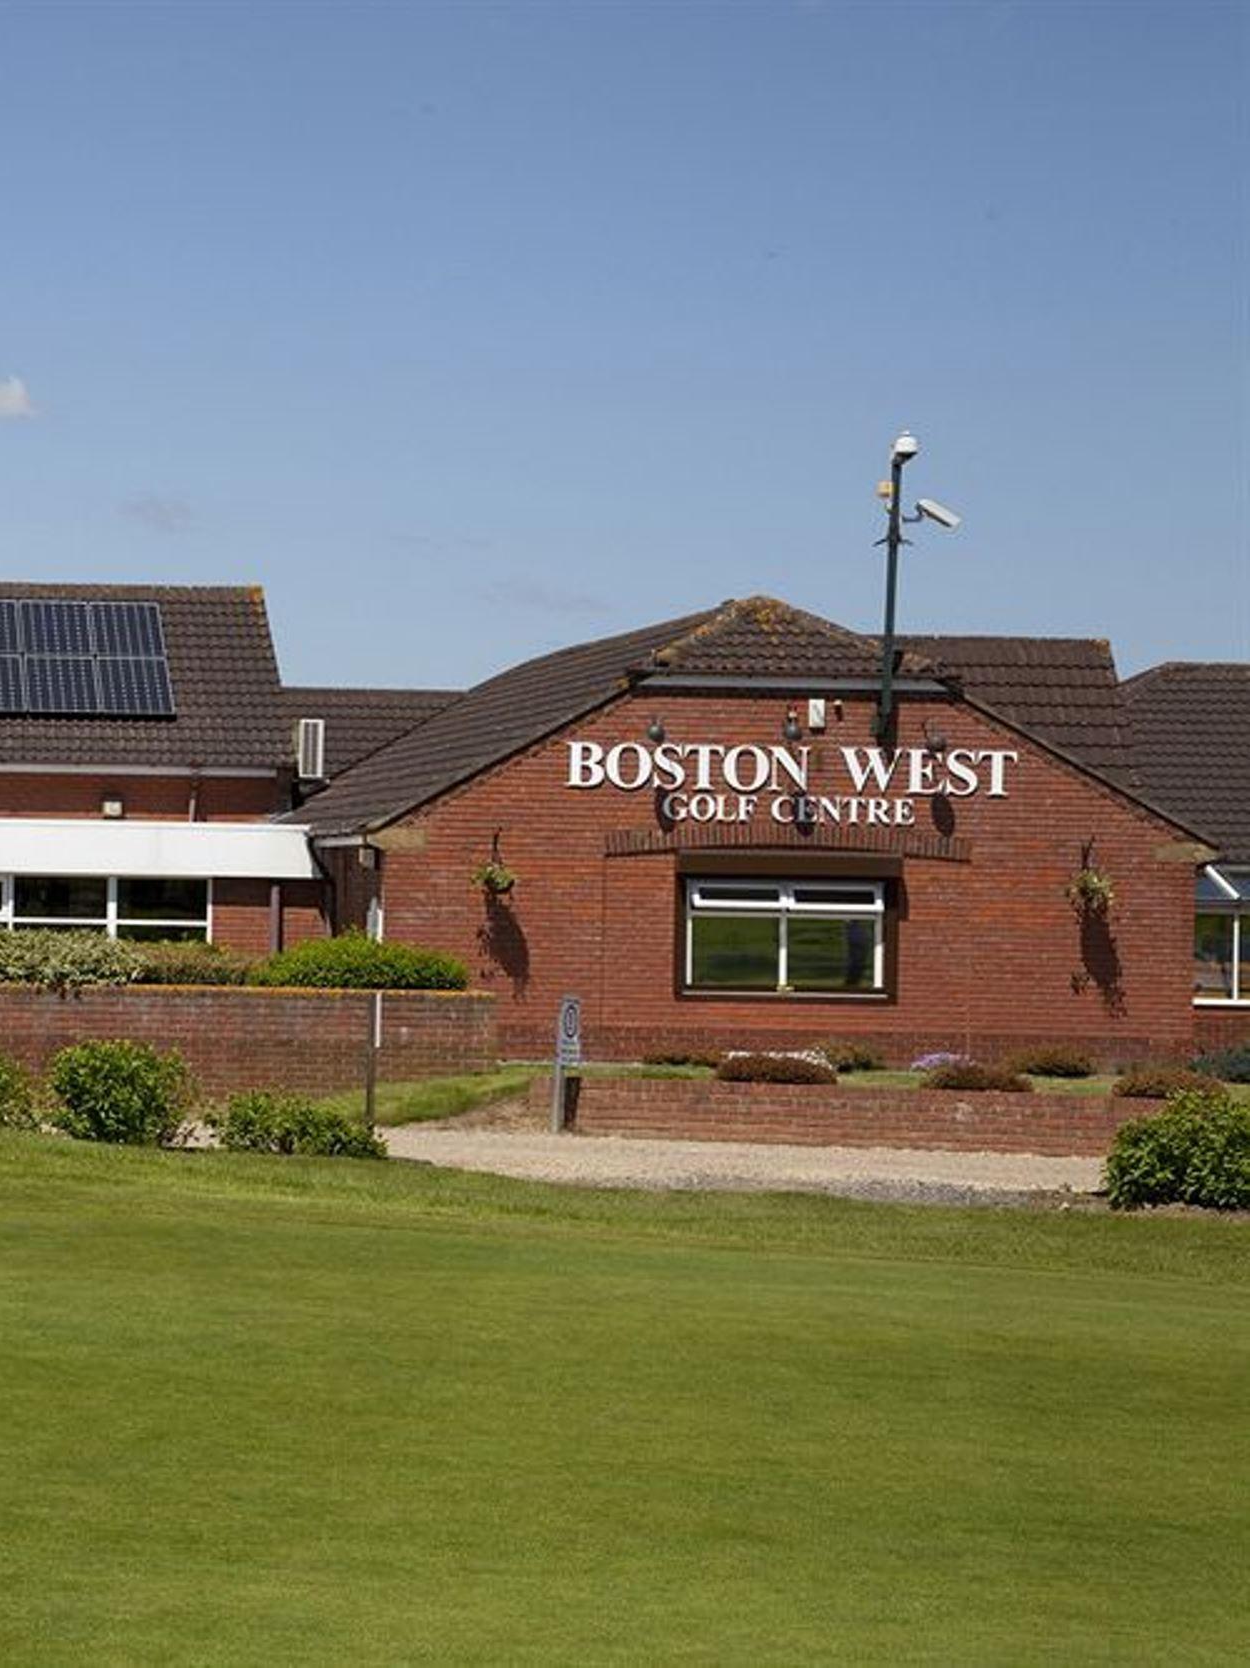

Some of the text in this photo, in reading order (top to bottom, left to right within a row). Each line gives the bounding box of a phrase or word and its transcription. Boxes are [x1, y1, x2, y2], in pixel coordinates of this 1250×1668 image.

[566, 741, 1018, 797] BOSTON WEST
[662, 794, 915, 825] GOLF CENTRE
